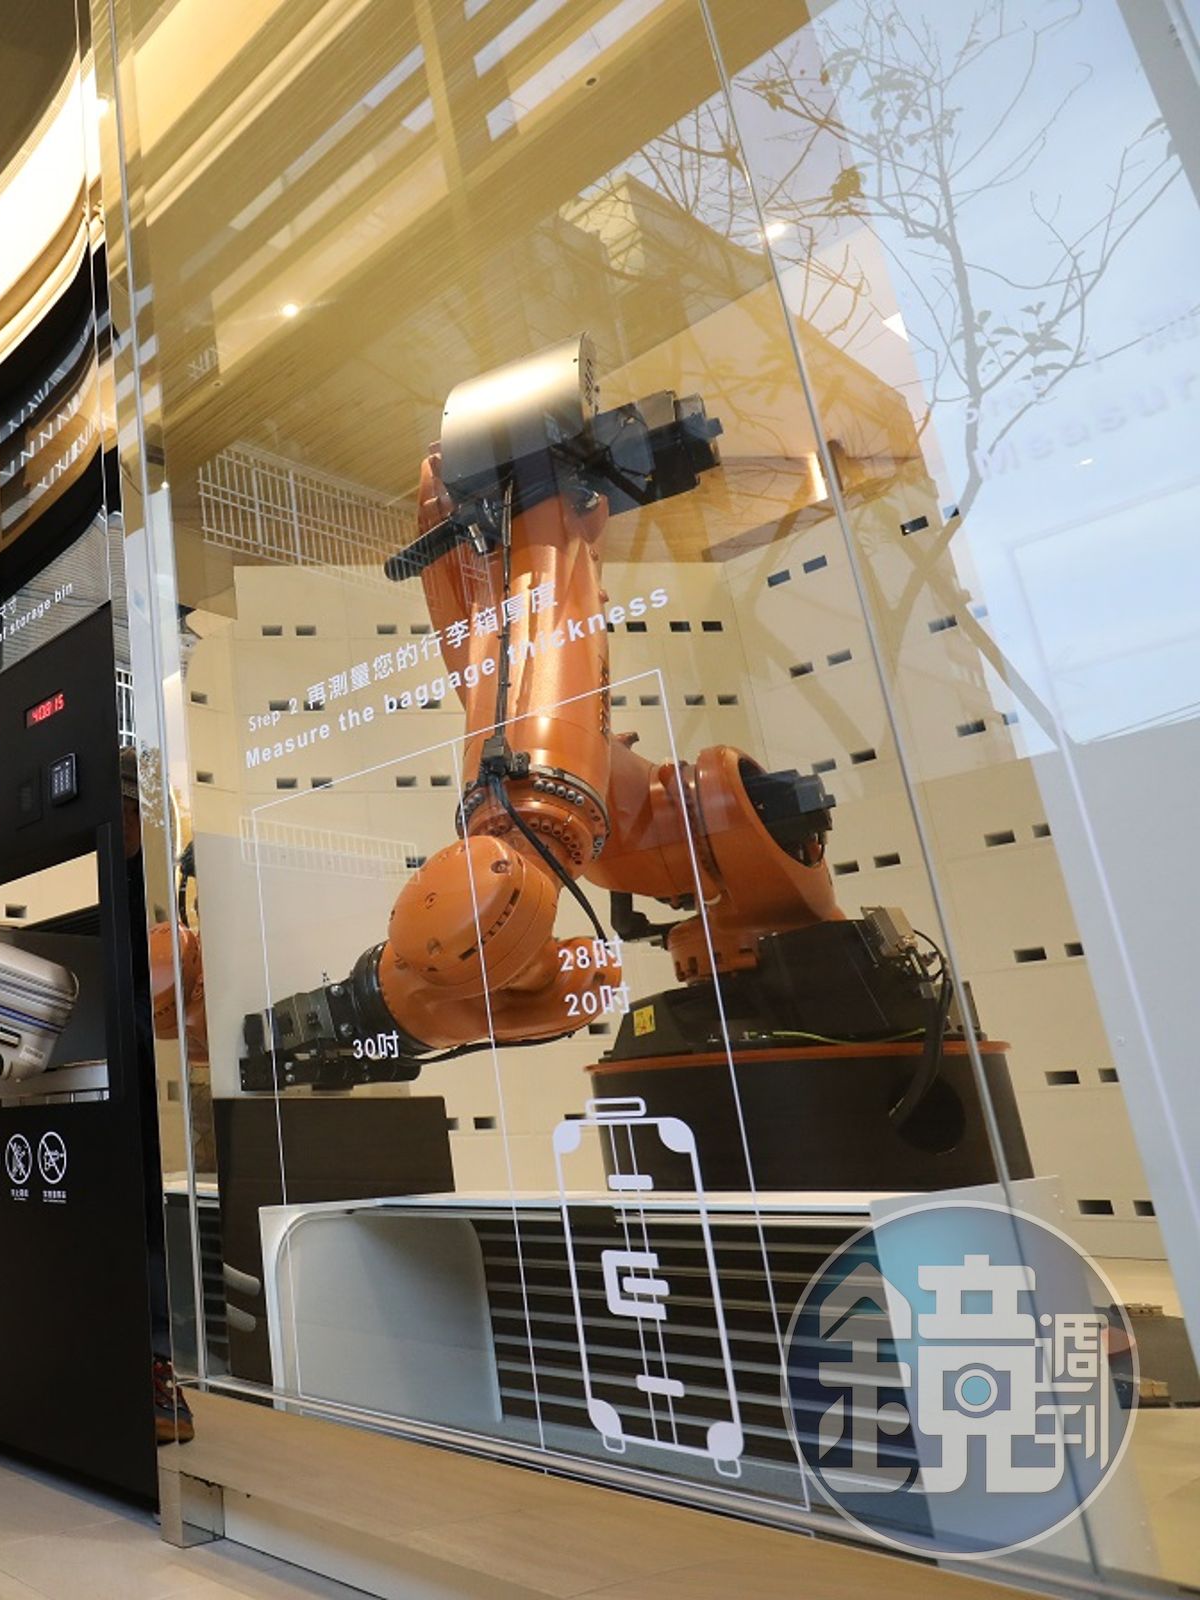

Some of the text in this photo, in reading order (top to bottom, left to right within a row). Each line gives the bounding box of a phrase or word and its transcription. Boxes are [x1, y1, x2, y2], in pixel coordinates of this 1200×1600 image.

[10, 599, 51, 635] storage
[55, 583, 72, 603] bin
[246, 587, 669, 768] Measure the baggage thickness
[248, 581, 558, 732] Step 2 再測量您的行李箱厚度
[558, 933, 624, 972] 28吋
[564, 980, 630, 1017] 20吋
[352, 1029, 399, 1060] 30吋
